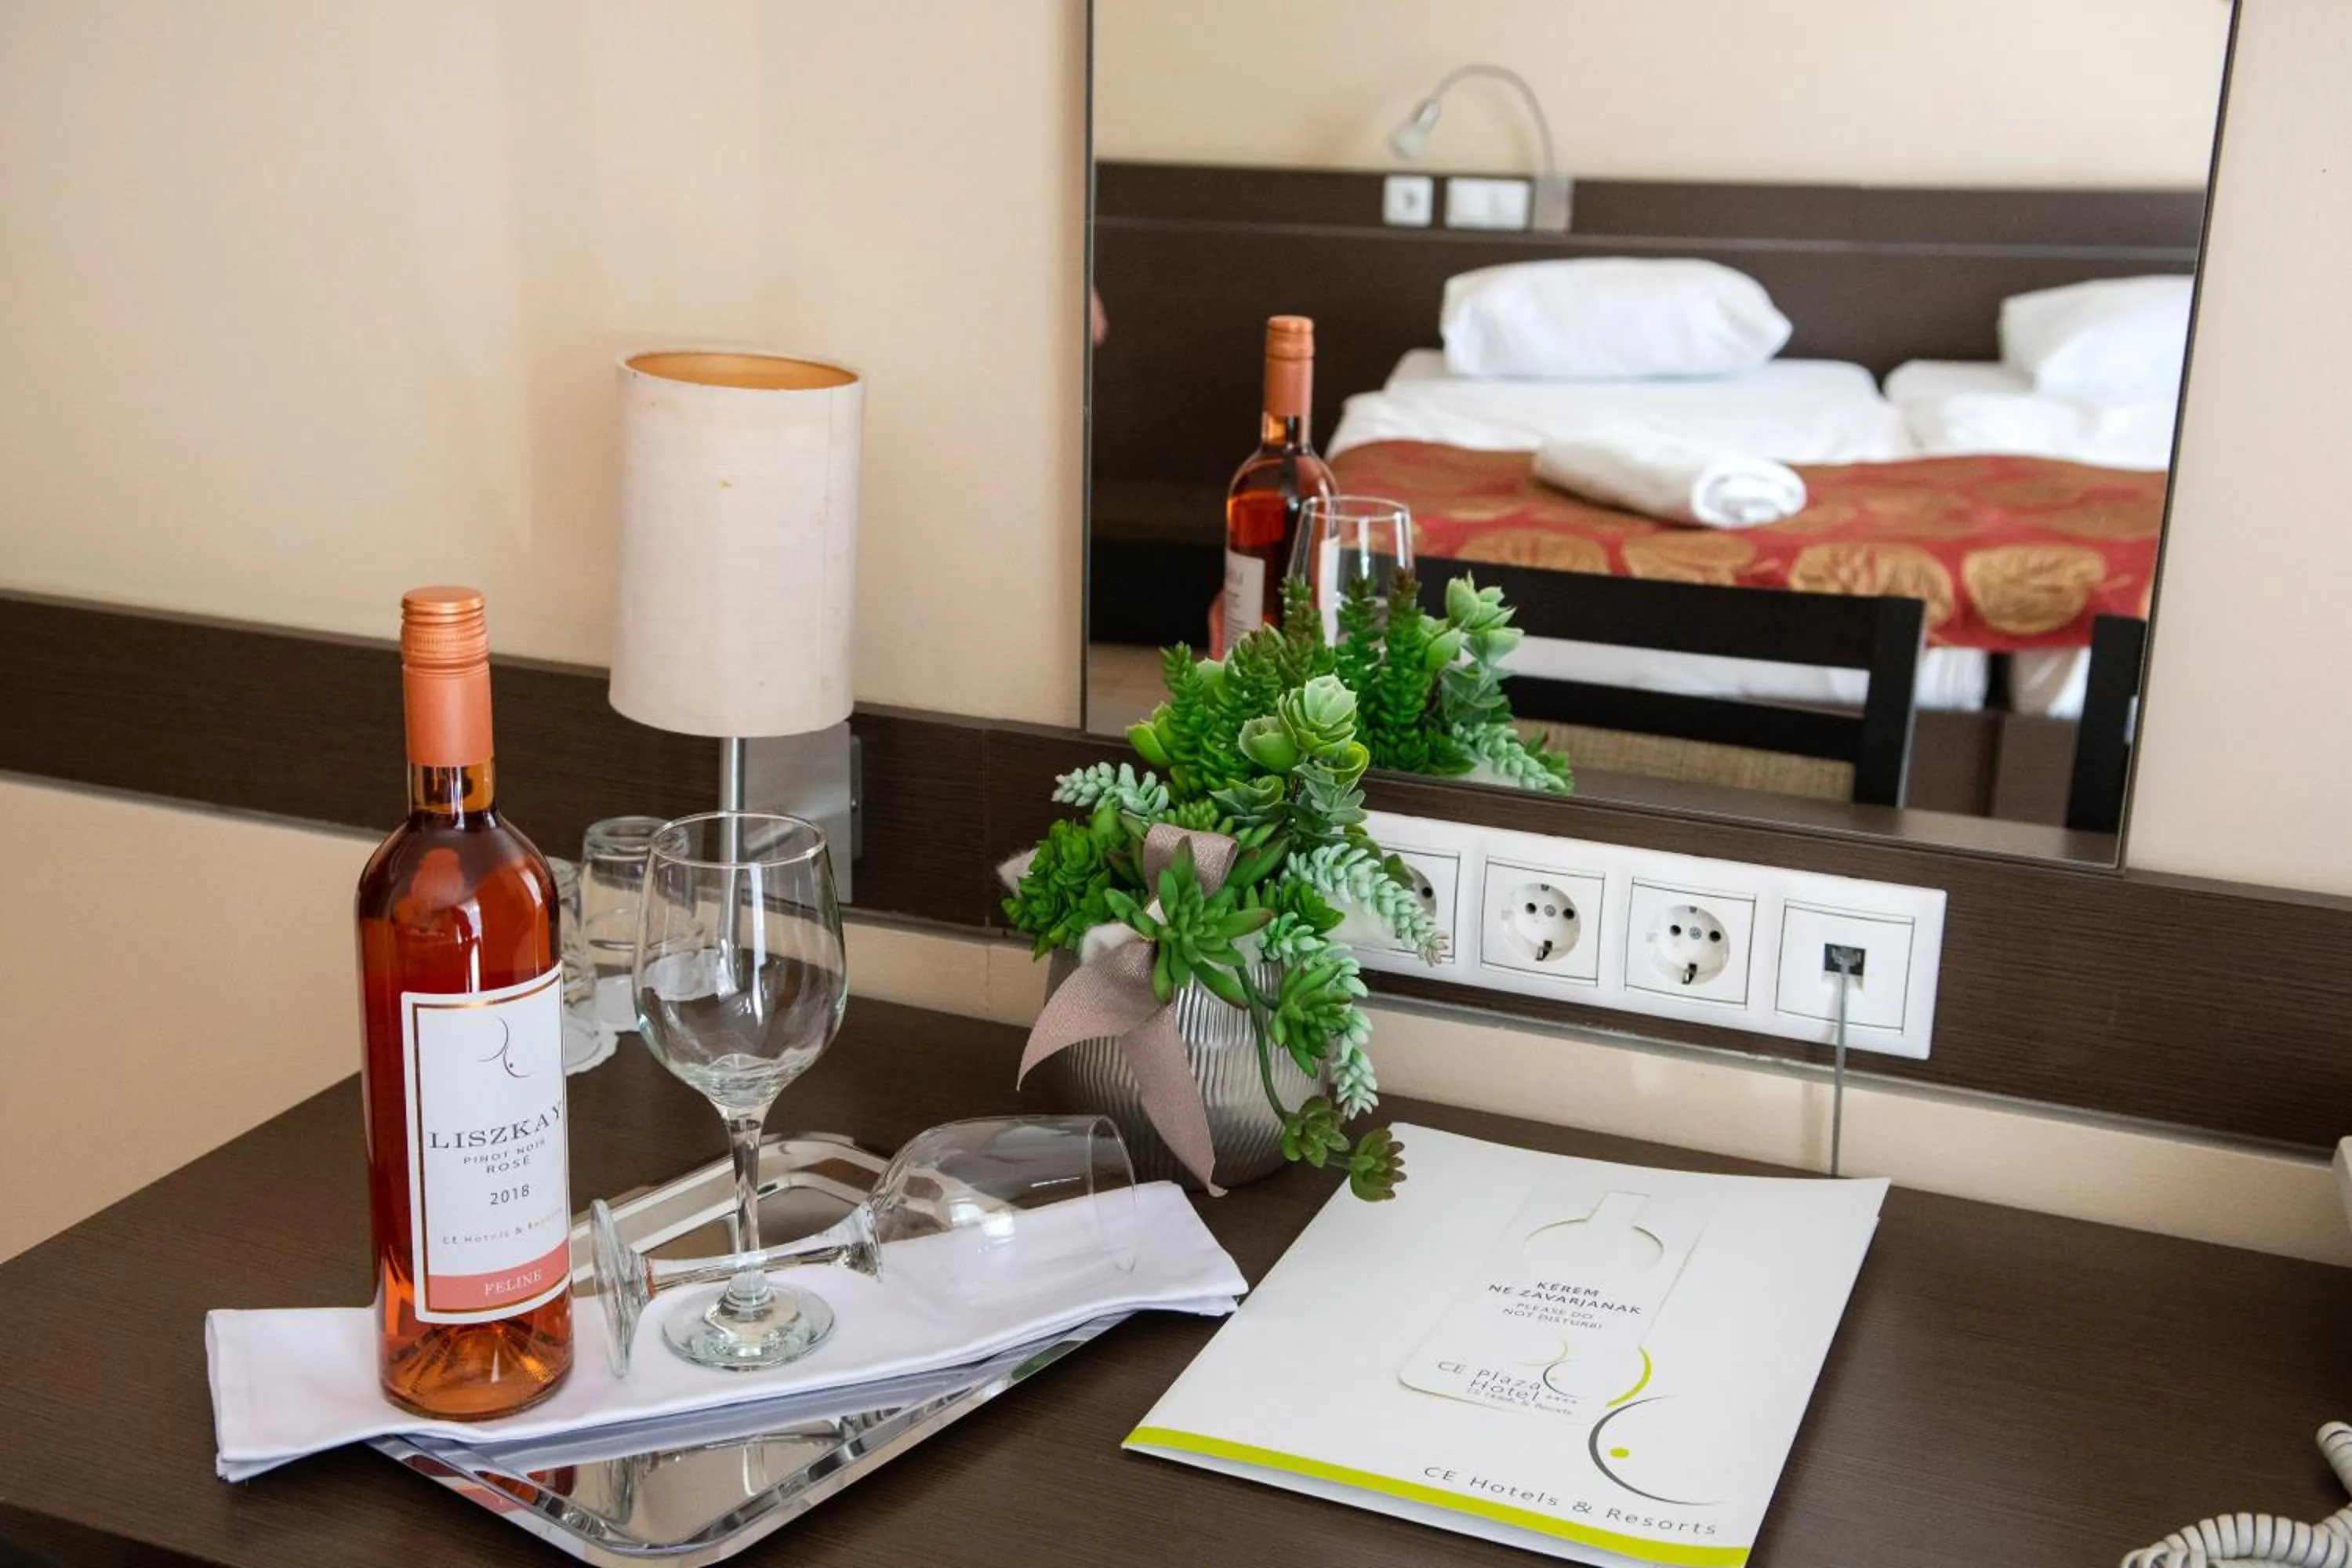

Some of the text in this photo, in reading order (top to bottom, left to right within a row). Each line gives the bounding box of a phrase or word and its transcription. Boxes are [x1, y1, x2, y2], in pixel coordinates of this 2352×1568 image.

[428, 1101, 562, 1149] LISZKAY
[463, 1151, 508, 1164] PINOT
[490, 1184, 530, 1205] 2018
[484, 1269, 543, 1296] FELINE
[1488, 1283, 1515, 1294] NE
[1503, 1308, 1533, 1318] NOT
[1570, 1311, 1594, 1319] DO
[1437, 1361, 1541, 1391] CE Plaza
[1470, 1379, 1541, 1402] Hotel
[1424, 1466, 1717, 1536] CE Hotels & Resorts
